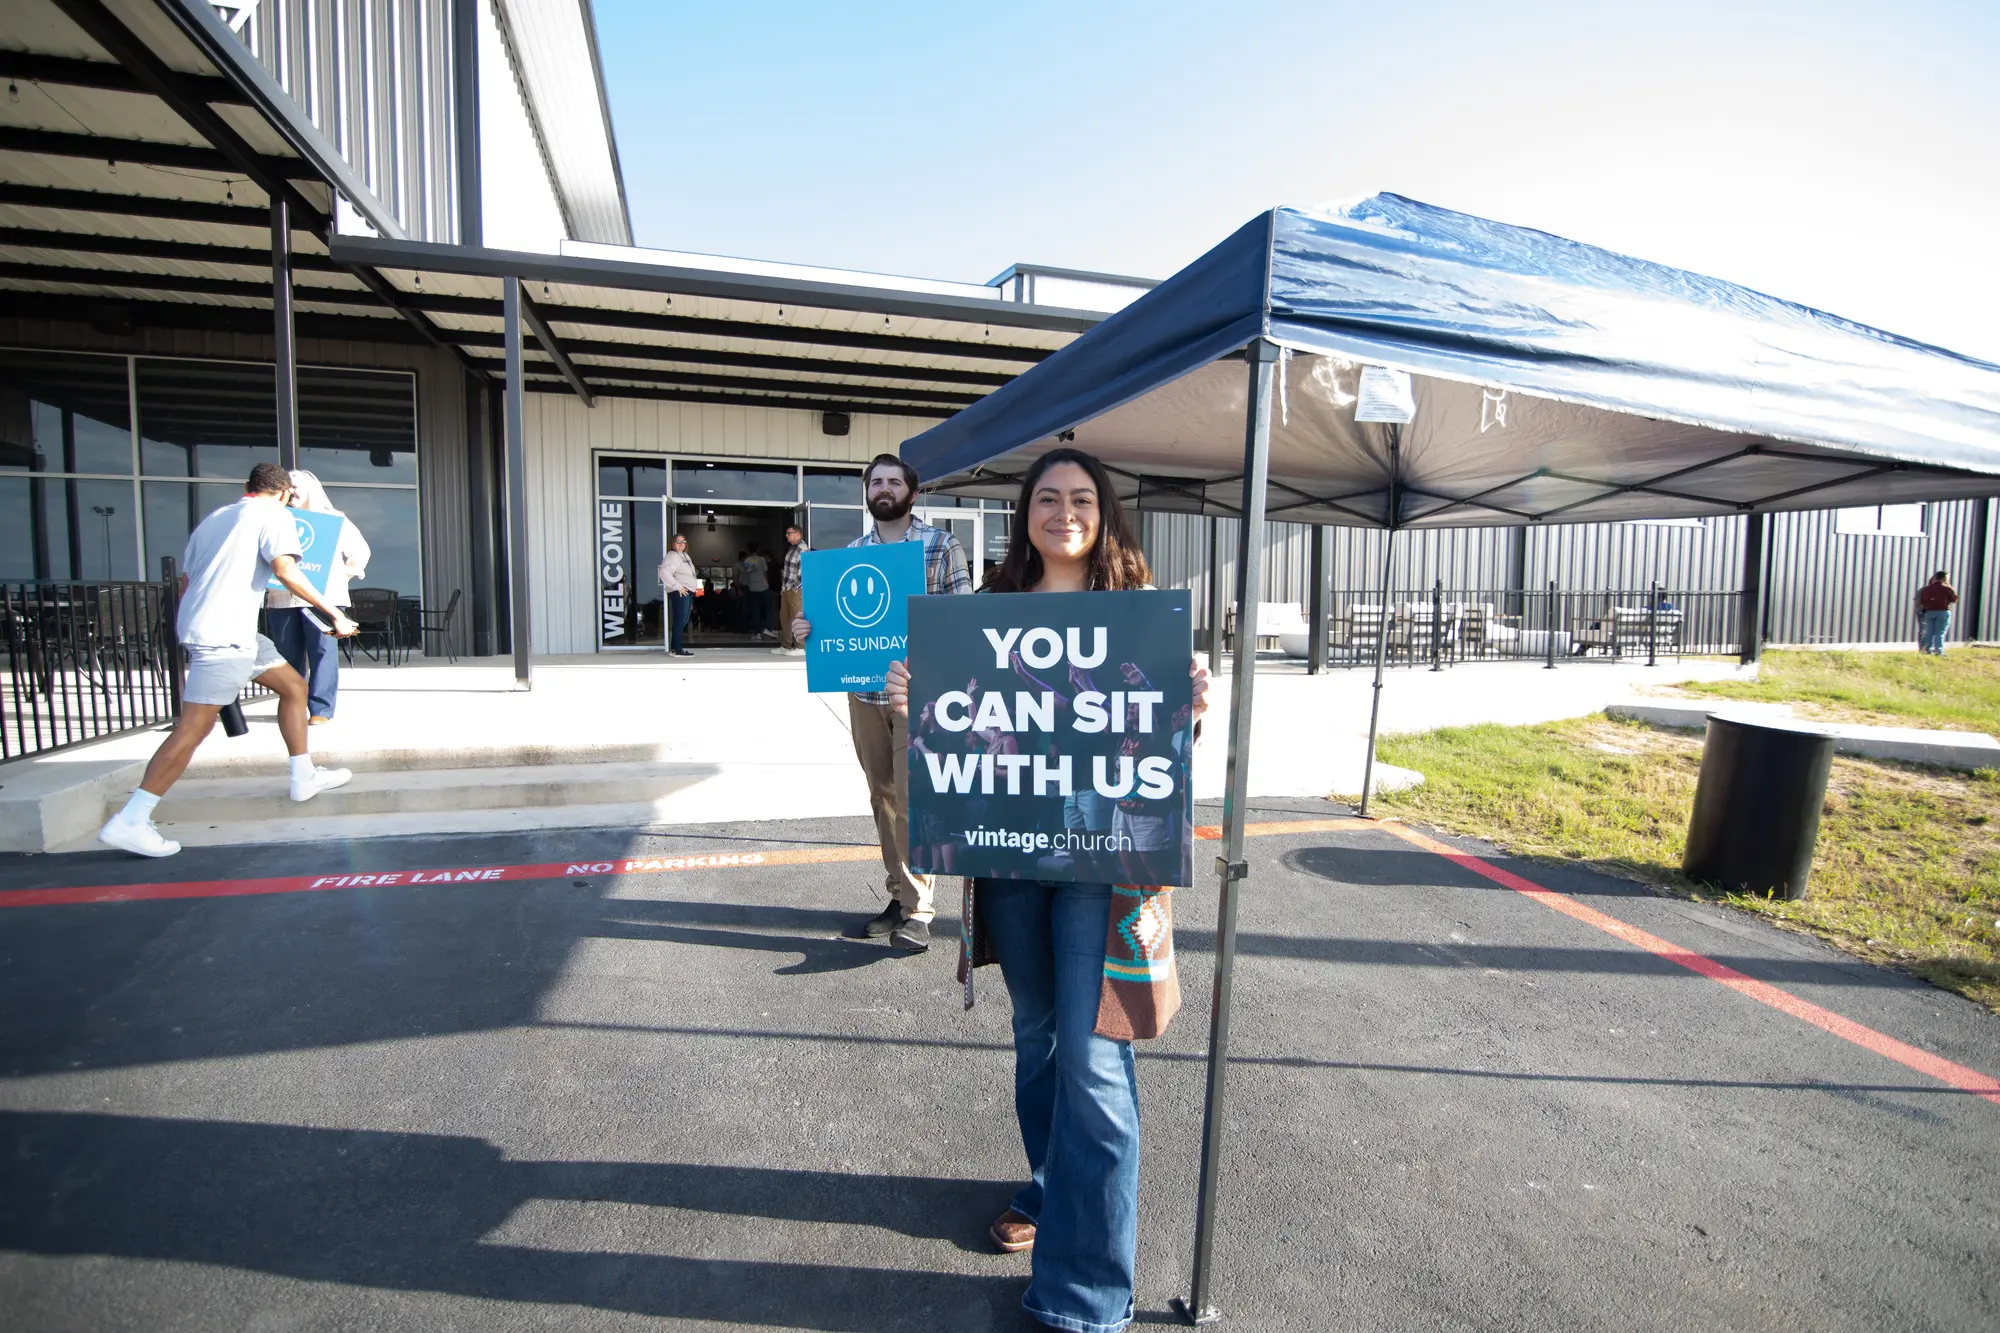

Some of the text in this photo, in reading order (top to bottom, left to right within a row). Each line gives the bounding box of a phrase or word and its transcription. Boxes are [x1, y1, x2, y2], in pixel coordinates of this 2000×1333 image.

[602, 503, 625, 639] WELCOME
[820, 638, 845, 653] IT'S
[982, 627, 1108, 669] YOU
[840, 674, 888, 686] vintage.chu
[934, 691, 1164, 733] CAN SIT
[924, 753, 1175, 800] WITH US
[965, 825, 1132, 853] vintage.church
[311, 853, 764, 888] FIRE LANE NO PARKING
